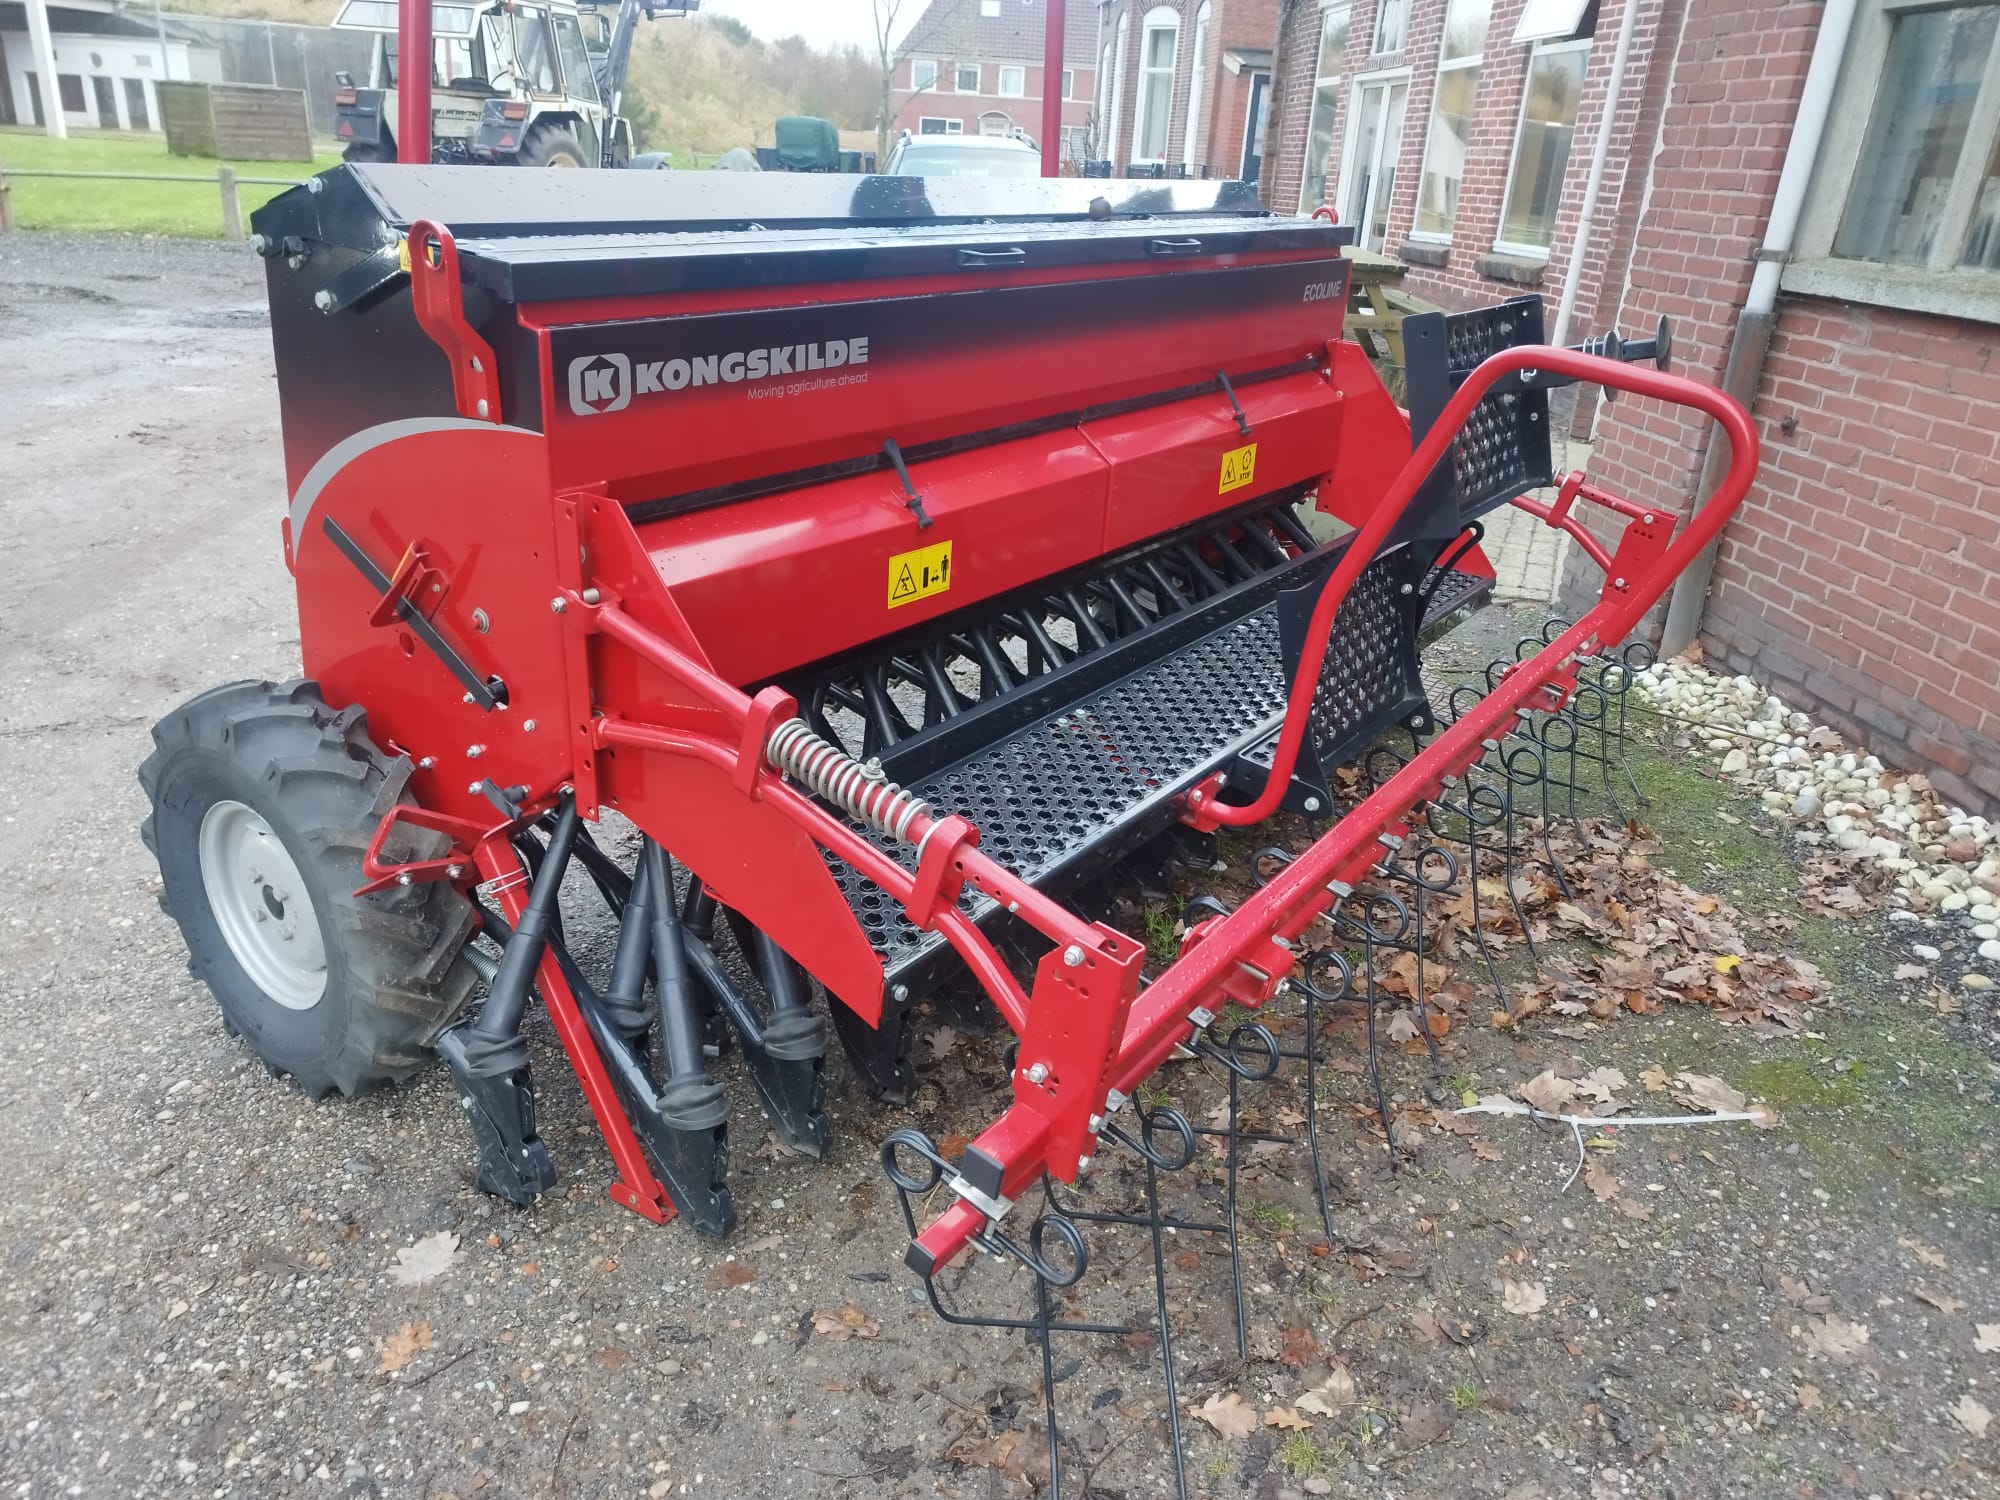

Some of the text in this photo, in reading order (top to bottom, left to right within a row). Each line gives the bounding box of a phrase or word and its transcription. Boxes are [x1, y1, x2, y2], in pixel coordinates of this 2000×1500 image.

[1303, 280, 1342, 302] ECOLINE
[584, 337, 868, 402] K KONGSKILDE
[747, 371, 868, 400] Moving agriculture ahead
[1239, 470, 1252, 481] STOP
